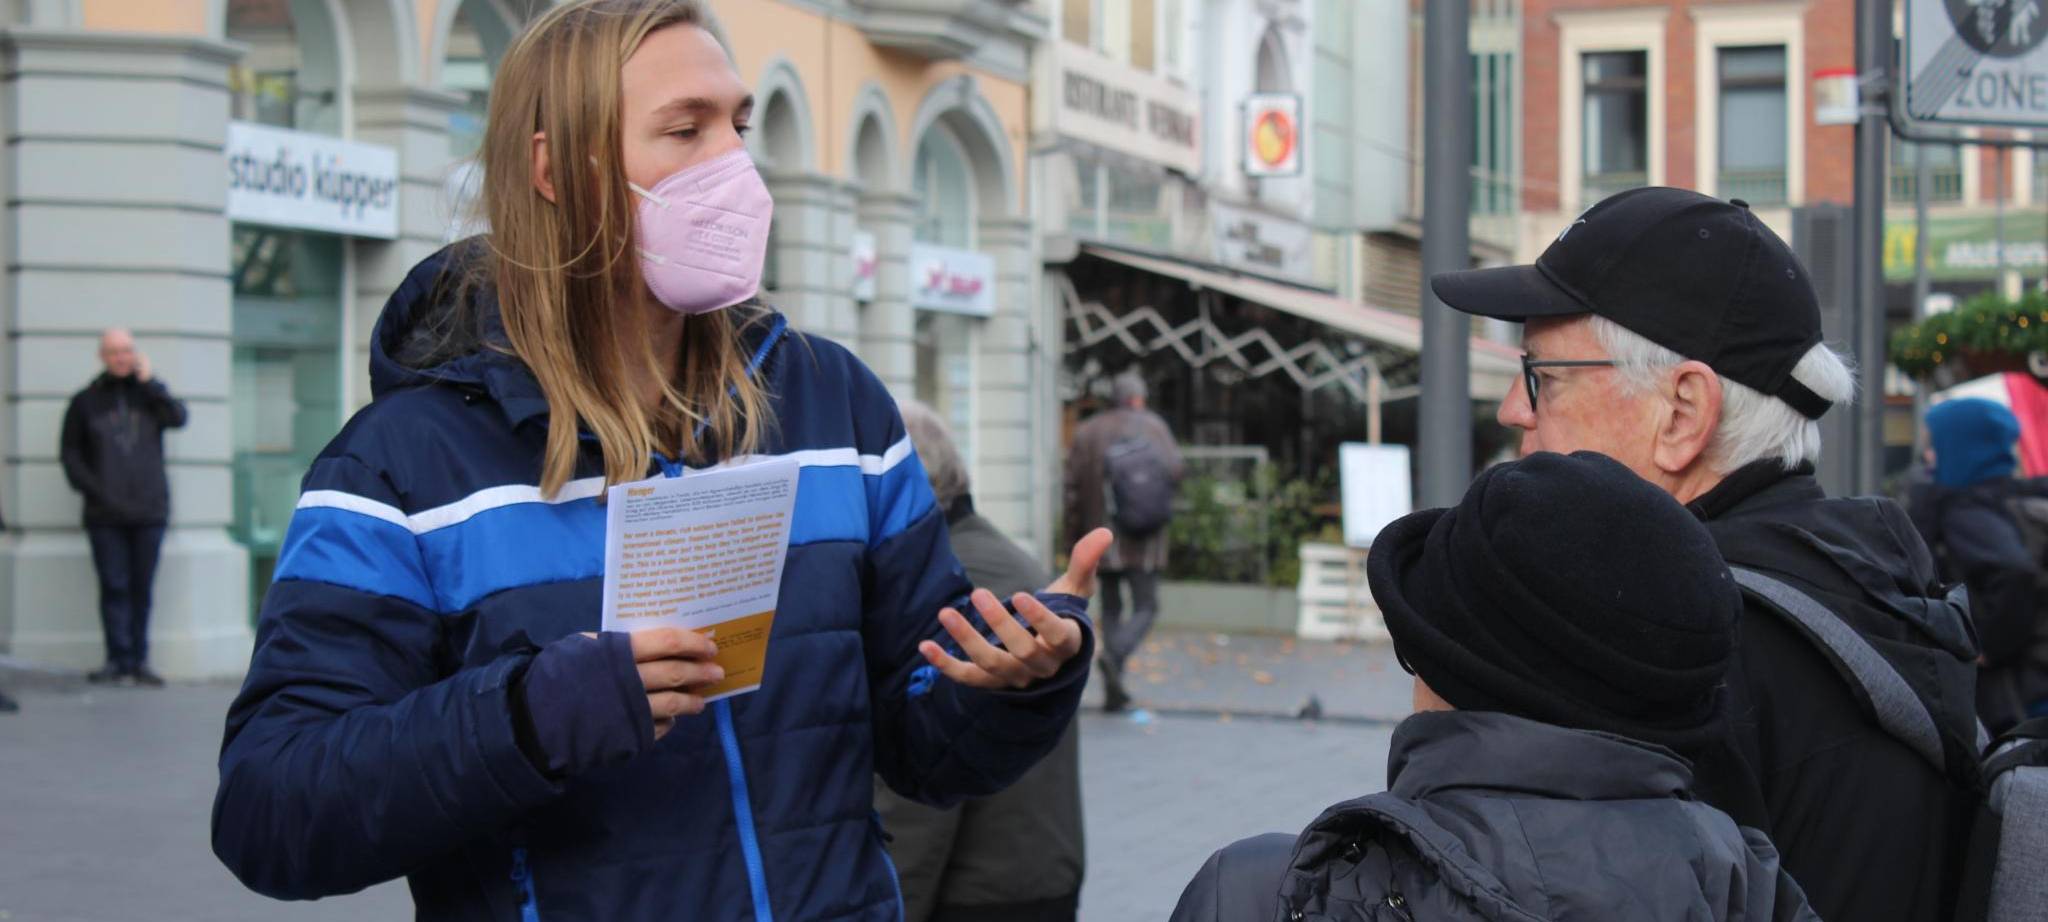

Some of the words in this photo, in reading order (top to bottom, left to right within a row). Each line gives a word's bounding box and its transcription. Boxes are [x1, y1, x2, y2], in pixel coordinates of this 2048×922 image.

[1956, 68, 2048, 111] ZONE
[229, 147, 308, 199] studio
[313, 150, 395, 220] küpper
